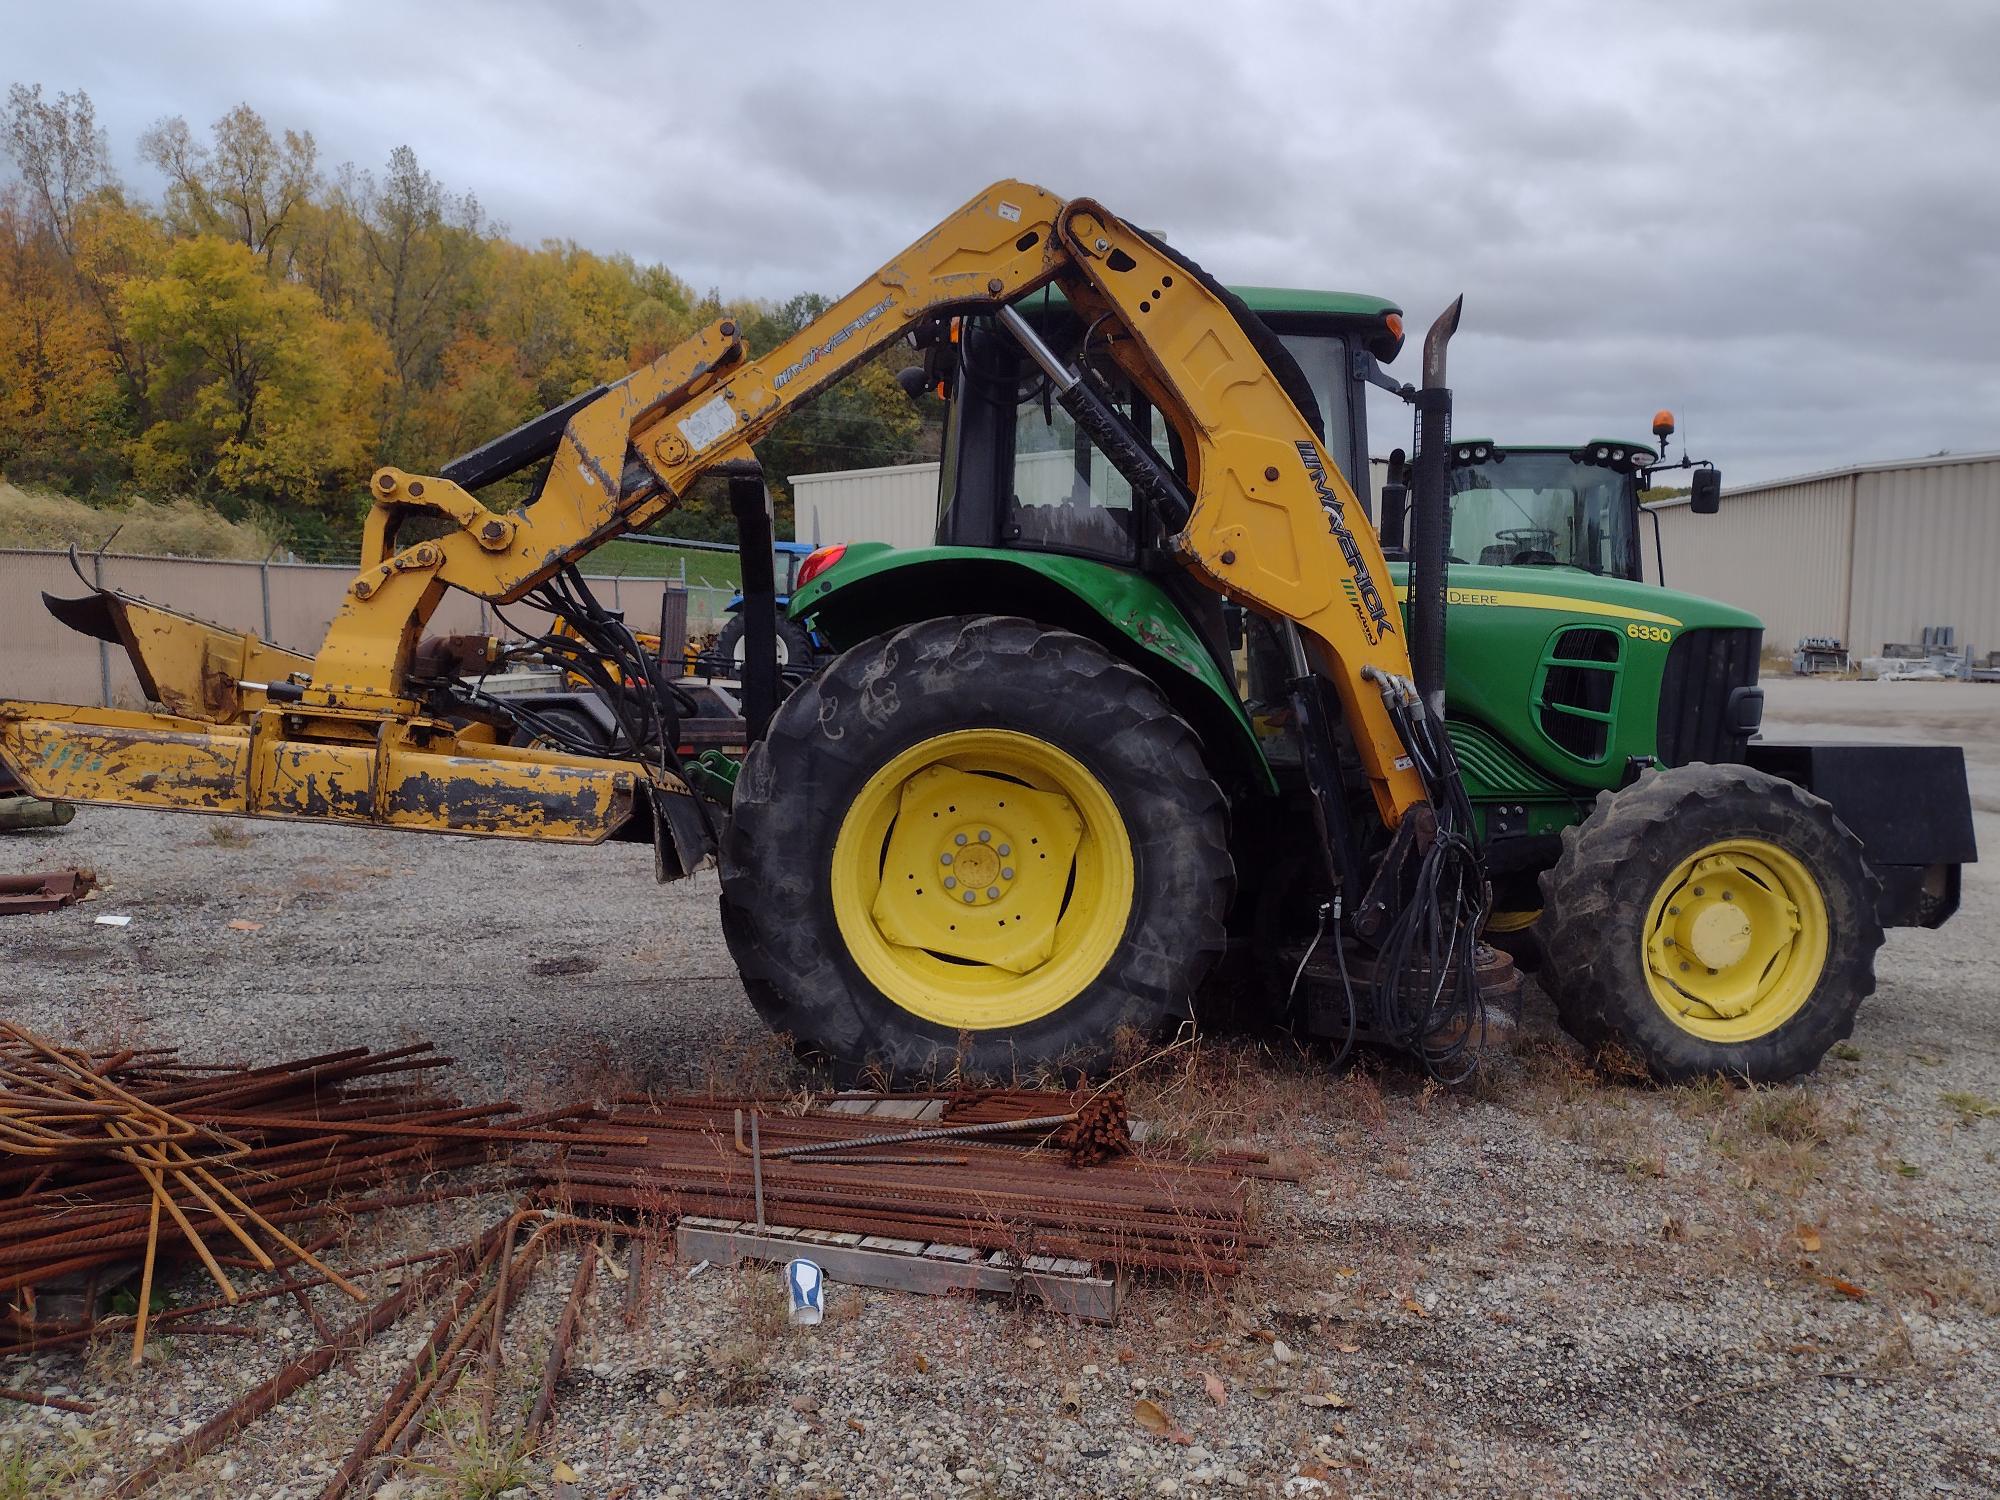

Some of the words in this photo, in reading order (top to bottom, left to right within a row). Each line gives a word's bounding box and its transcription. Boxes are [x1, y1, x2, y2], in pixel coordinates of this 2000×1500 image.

[788, 293, 897, 377] MAVERICK
[1308, 466, 1396, 640] MAVERICK
[1449, 591, 1498, 604] DEERE
[1626, 623, 1672, 643] 6330
